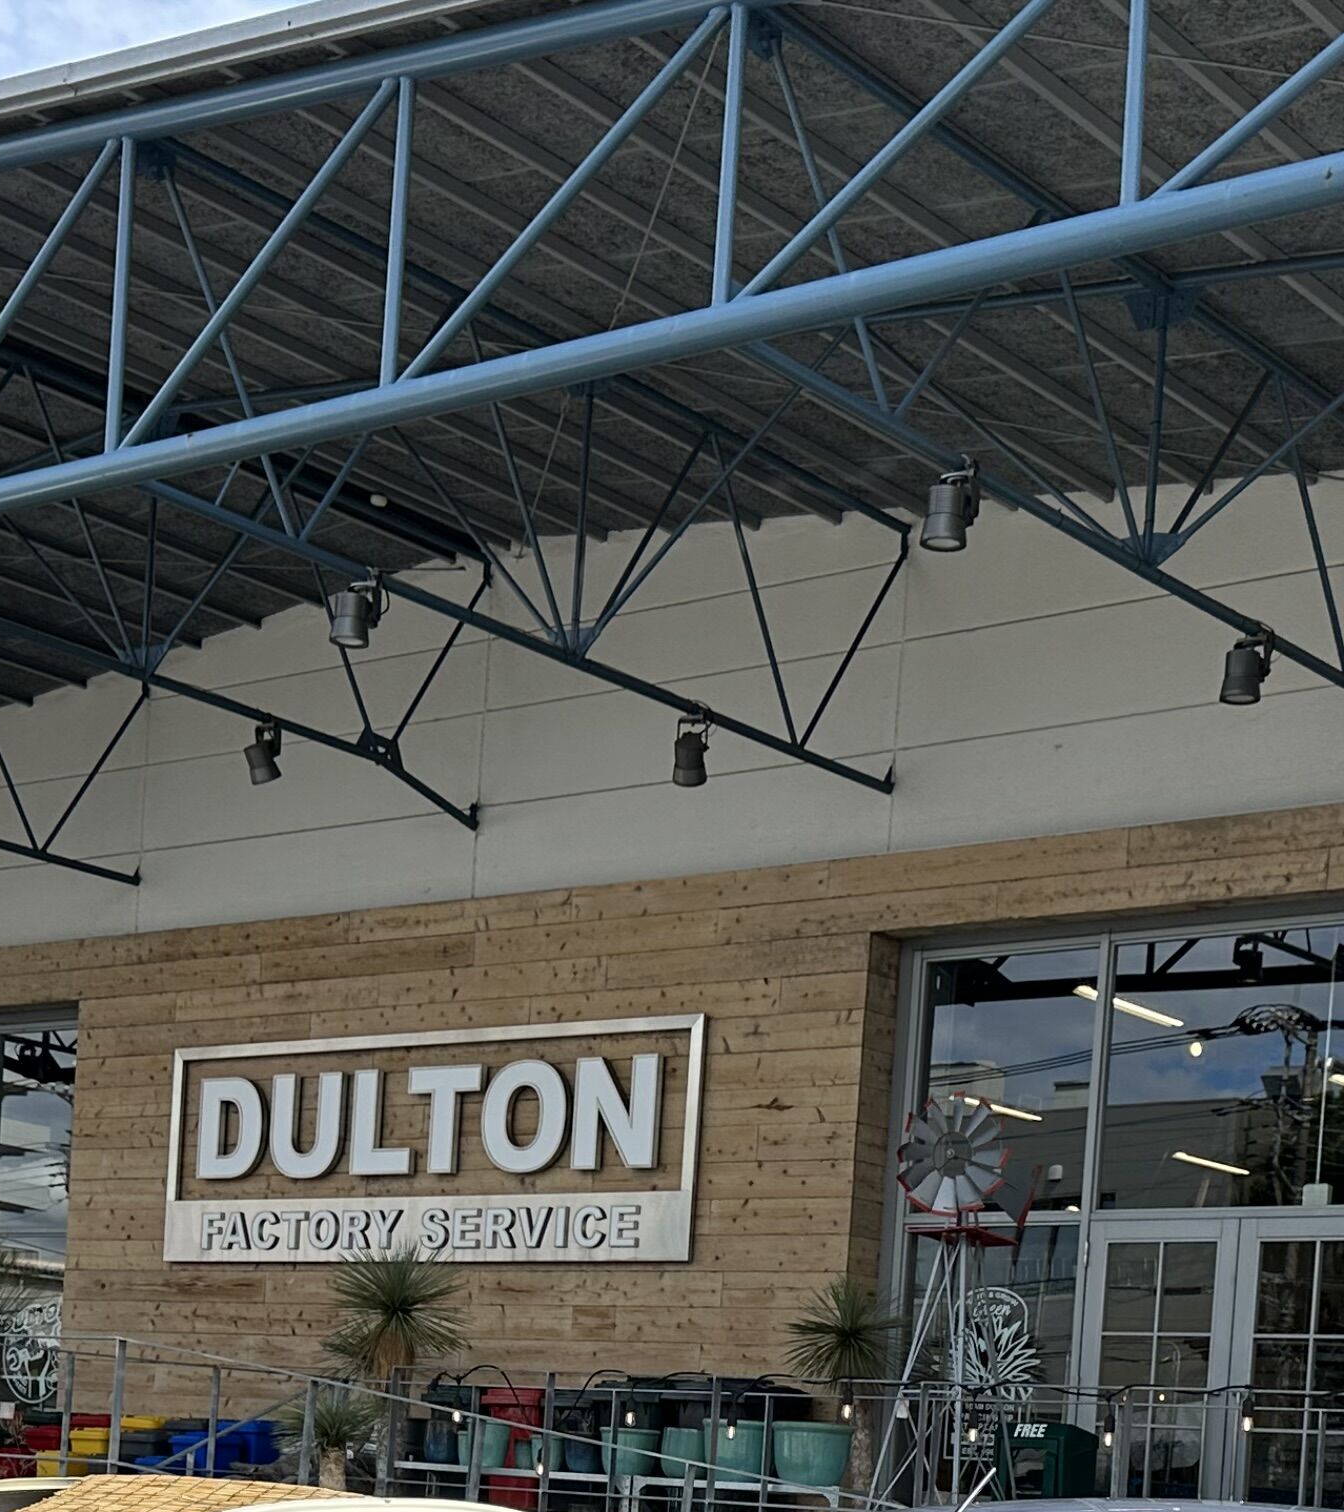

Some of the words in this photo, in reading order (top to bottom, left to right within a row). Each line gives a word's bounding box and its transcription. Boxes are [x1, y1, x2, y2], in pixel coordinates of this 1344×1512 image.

[196, 1053, 664, 1180] DULTON
[200, 1208, 404, 1251] FACTORY
[418, 1204, 643, 1250] SERVICE
[1014, 1423, 1048, 1438] FREE
